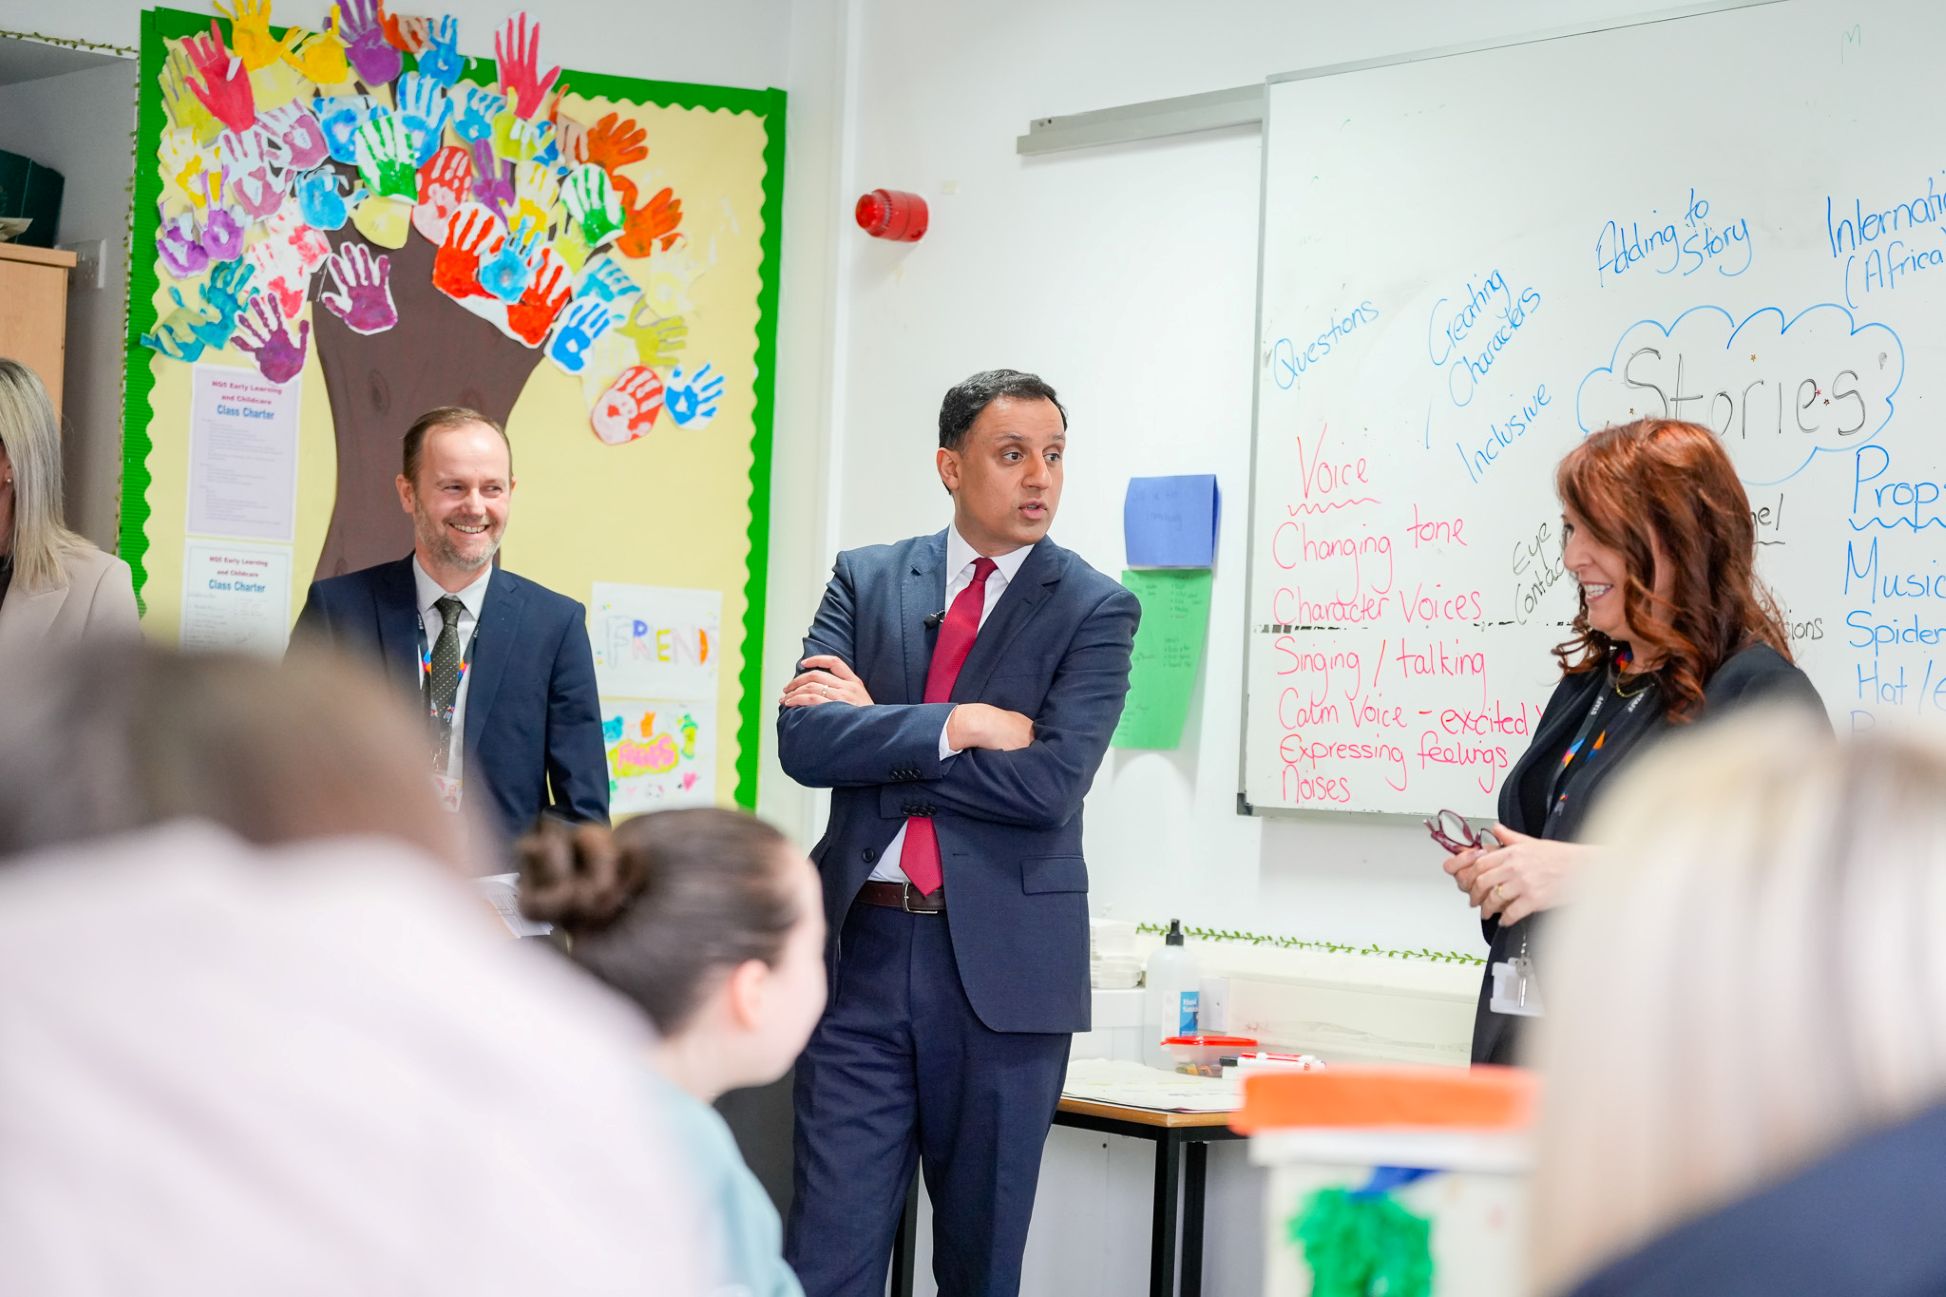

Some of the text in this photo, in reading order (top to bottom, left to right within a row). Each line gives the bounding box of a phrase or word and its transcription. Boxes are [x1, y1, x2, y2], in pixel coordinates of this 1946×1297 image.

[1596, 187, 1709, 287] Adding to
[1683, 218, 1751, 276] Story
[1827, 169, 1946, 258] Internati
[1274, 301, 1379, 390] Questions
[1429, 269, 1512, 365] Creating
[1449, 287, 1541, 407] Characters
[216, 404, 275, 420] Class Charter
[1456, 384, 1551, 483] Inclusive
[1297, 422, 1369, 499] Voice
[1853, 445, 1946, 533] Prop
[208, 579, 266, 593] Class Charter
[1273, 521, 1393, 603] Changing
[1406, 503, 1468, 549] tone
[1513, 522, 1552, 576] Eye
[1274, 583, 1482, 625] Character Voices
[1515, 555, 1564, 625] Contac
[1275, 635, 1361, 706] Singing
[1396, 637, 1487, 715] talking
[1279, 687, 1339, 730] Calm
[1350, 694, 1408, 728] Voice
[1441, 700, 1529, 735] excited
[1857, 660, 1908, 705] Hat
[1280, 731, 1508, 794] Expressing feelings
